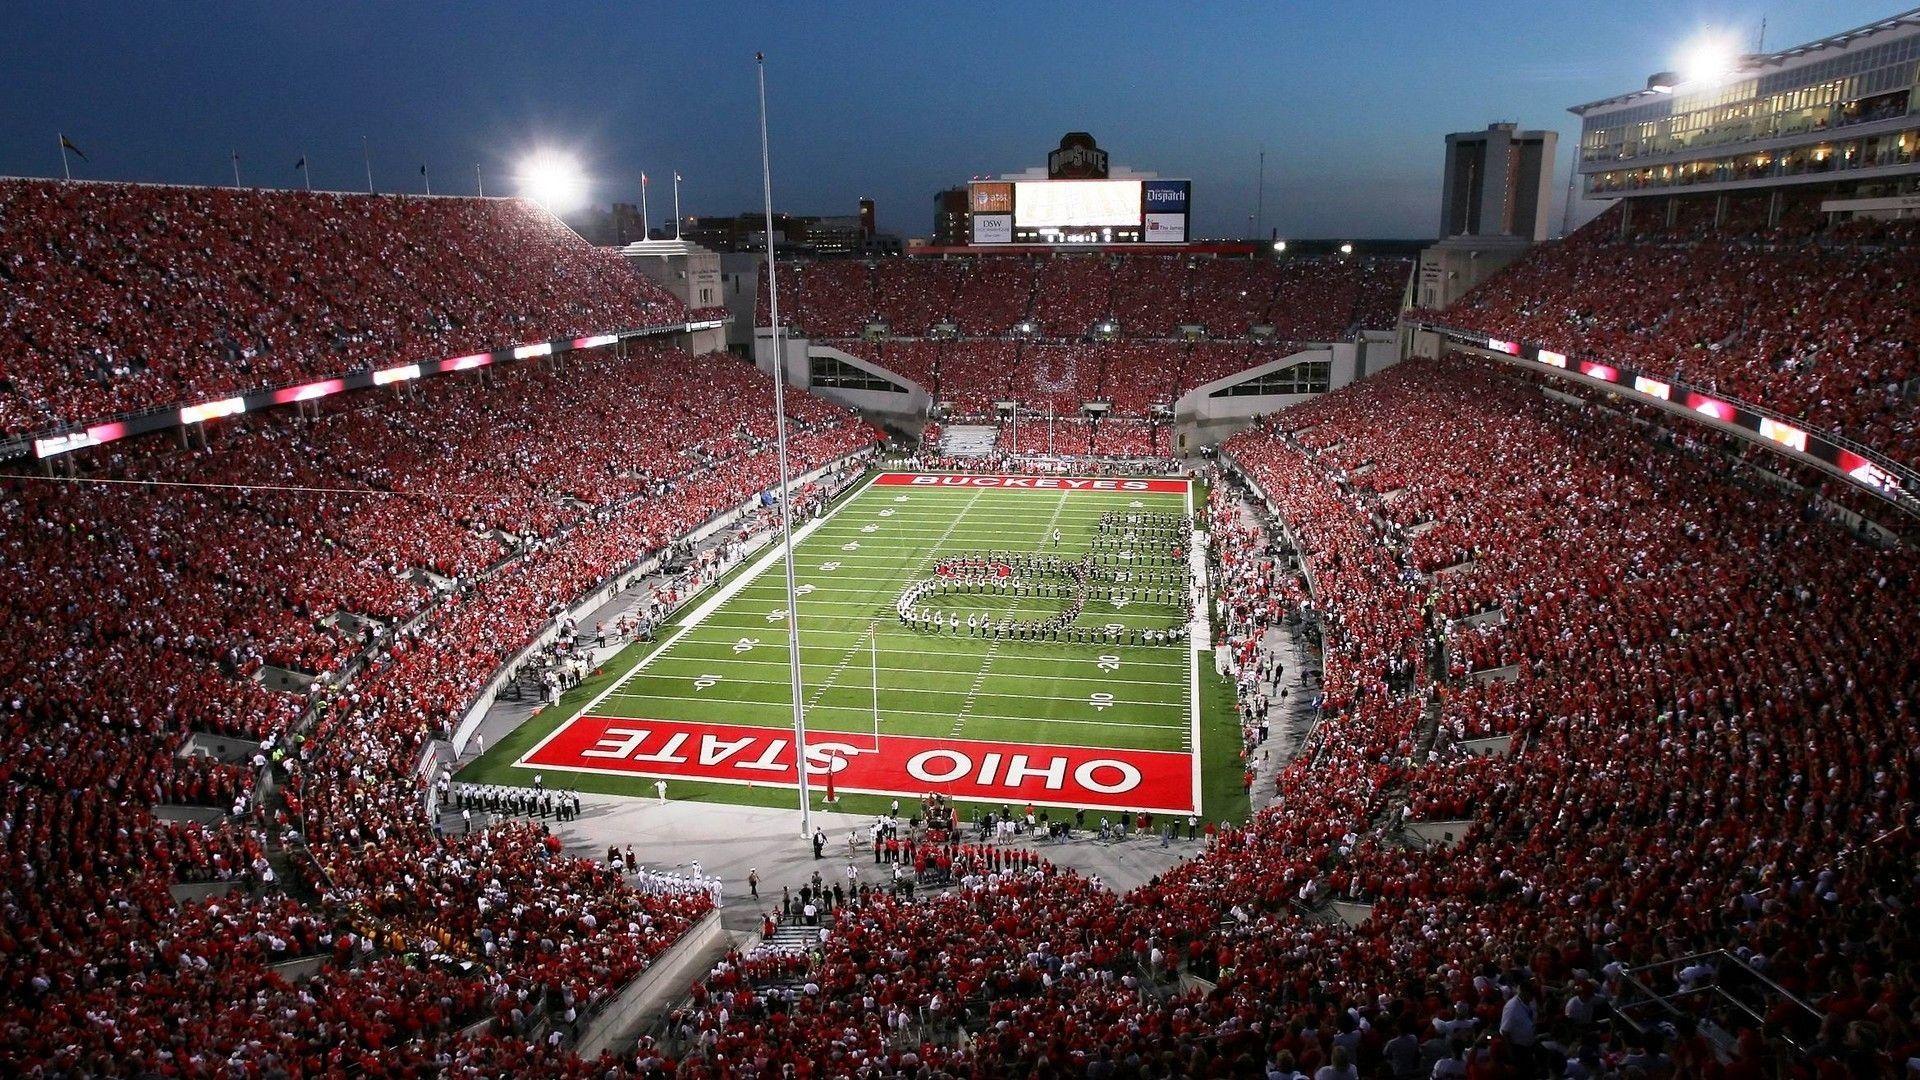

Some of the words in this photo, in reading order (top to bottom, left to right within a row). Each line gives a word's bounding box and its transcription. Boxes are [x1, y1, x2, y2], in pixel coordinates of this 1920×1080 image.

[1147, 190, 1185, 203] Dispatch
[911, 476, 1149, 490] BUCKEYES
[733, 638, 760, 652] 20
[1097, 655, 1120, 670] 20
[694, 675, 723, 688] 10
[1089, 693, 1114, 707] 10
[581, 728, 859, 775] STATE
[906, 749, 1142, 794] OHIO
